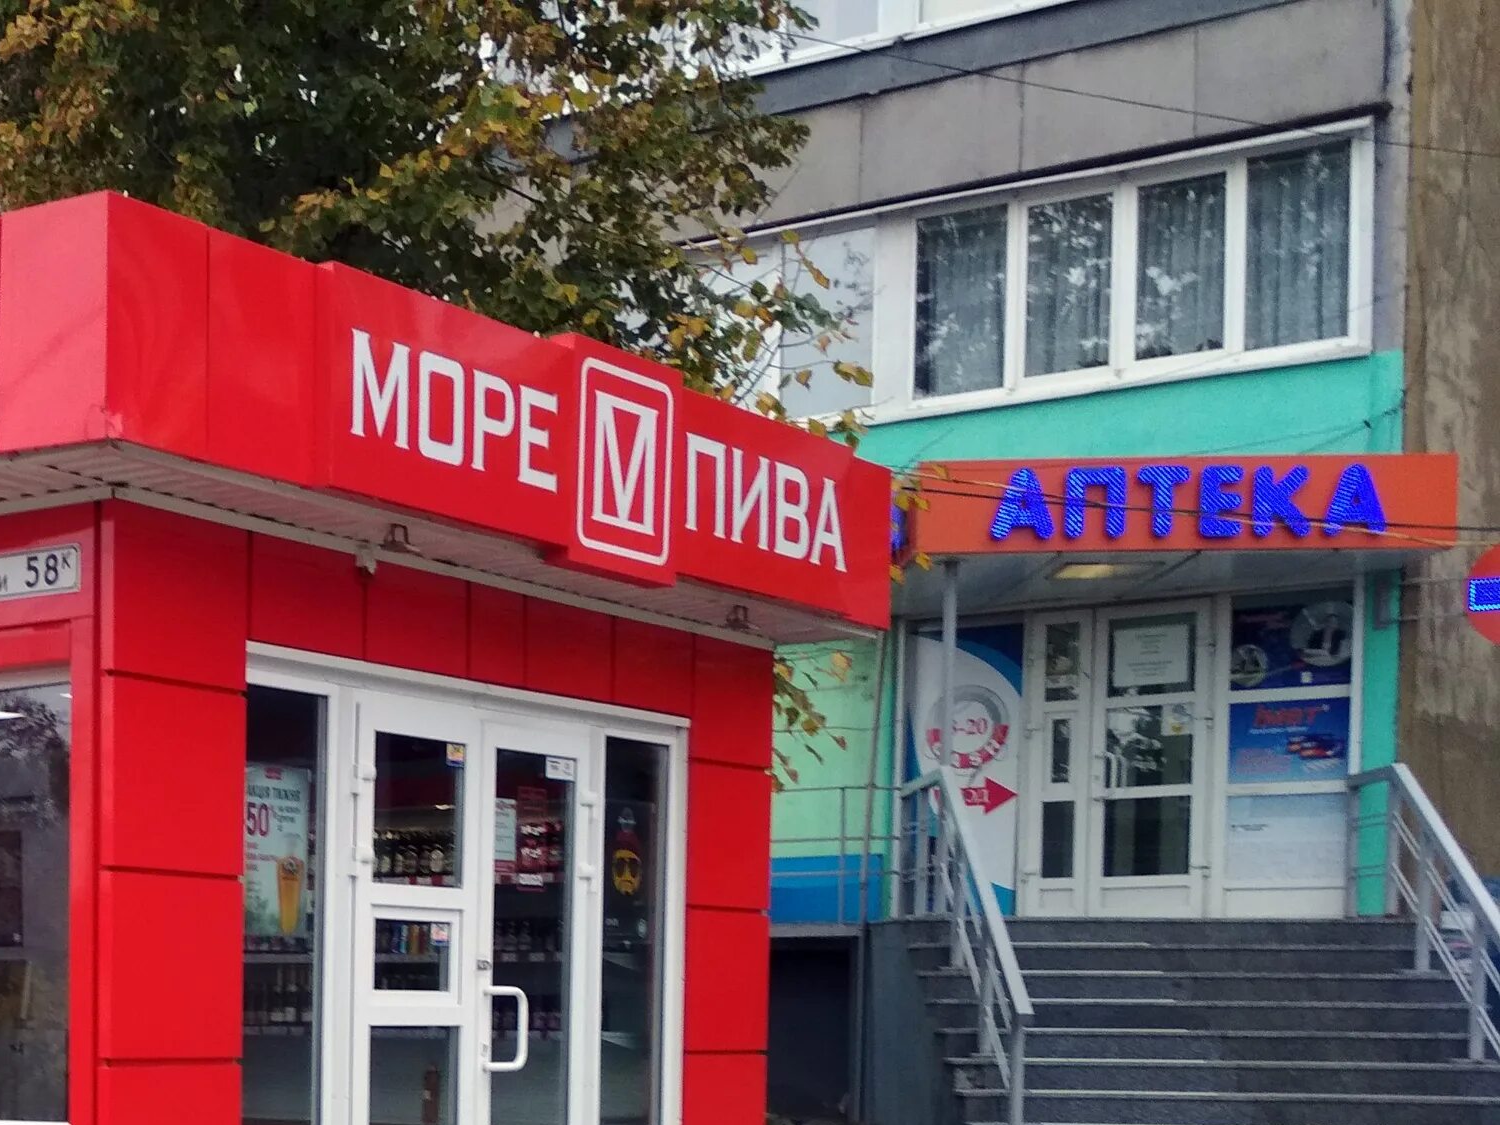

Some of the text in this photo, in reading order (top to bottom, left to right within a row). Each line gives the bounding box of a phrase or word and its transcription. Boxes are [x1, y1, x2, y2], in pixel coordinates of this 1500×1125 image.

[351, 328, 558, 493] МОРЕ
[684, 432, 848, 573] ПИВА
[989, 463, 1387, 540] АПТЕКА
